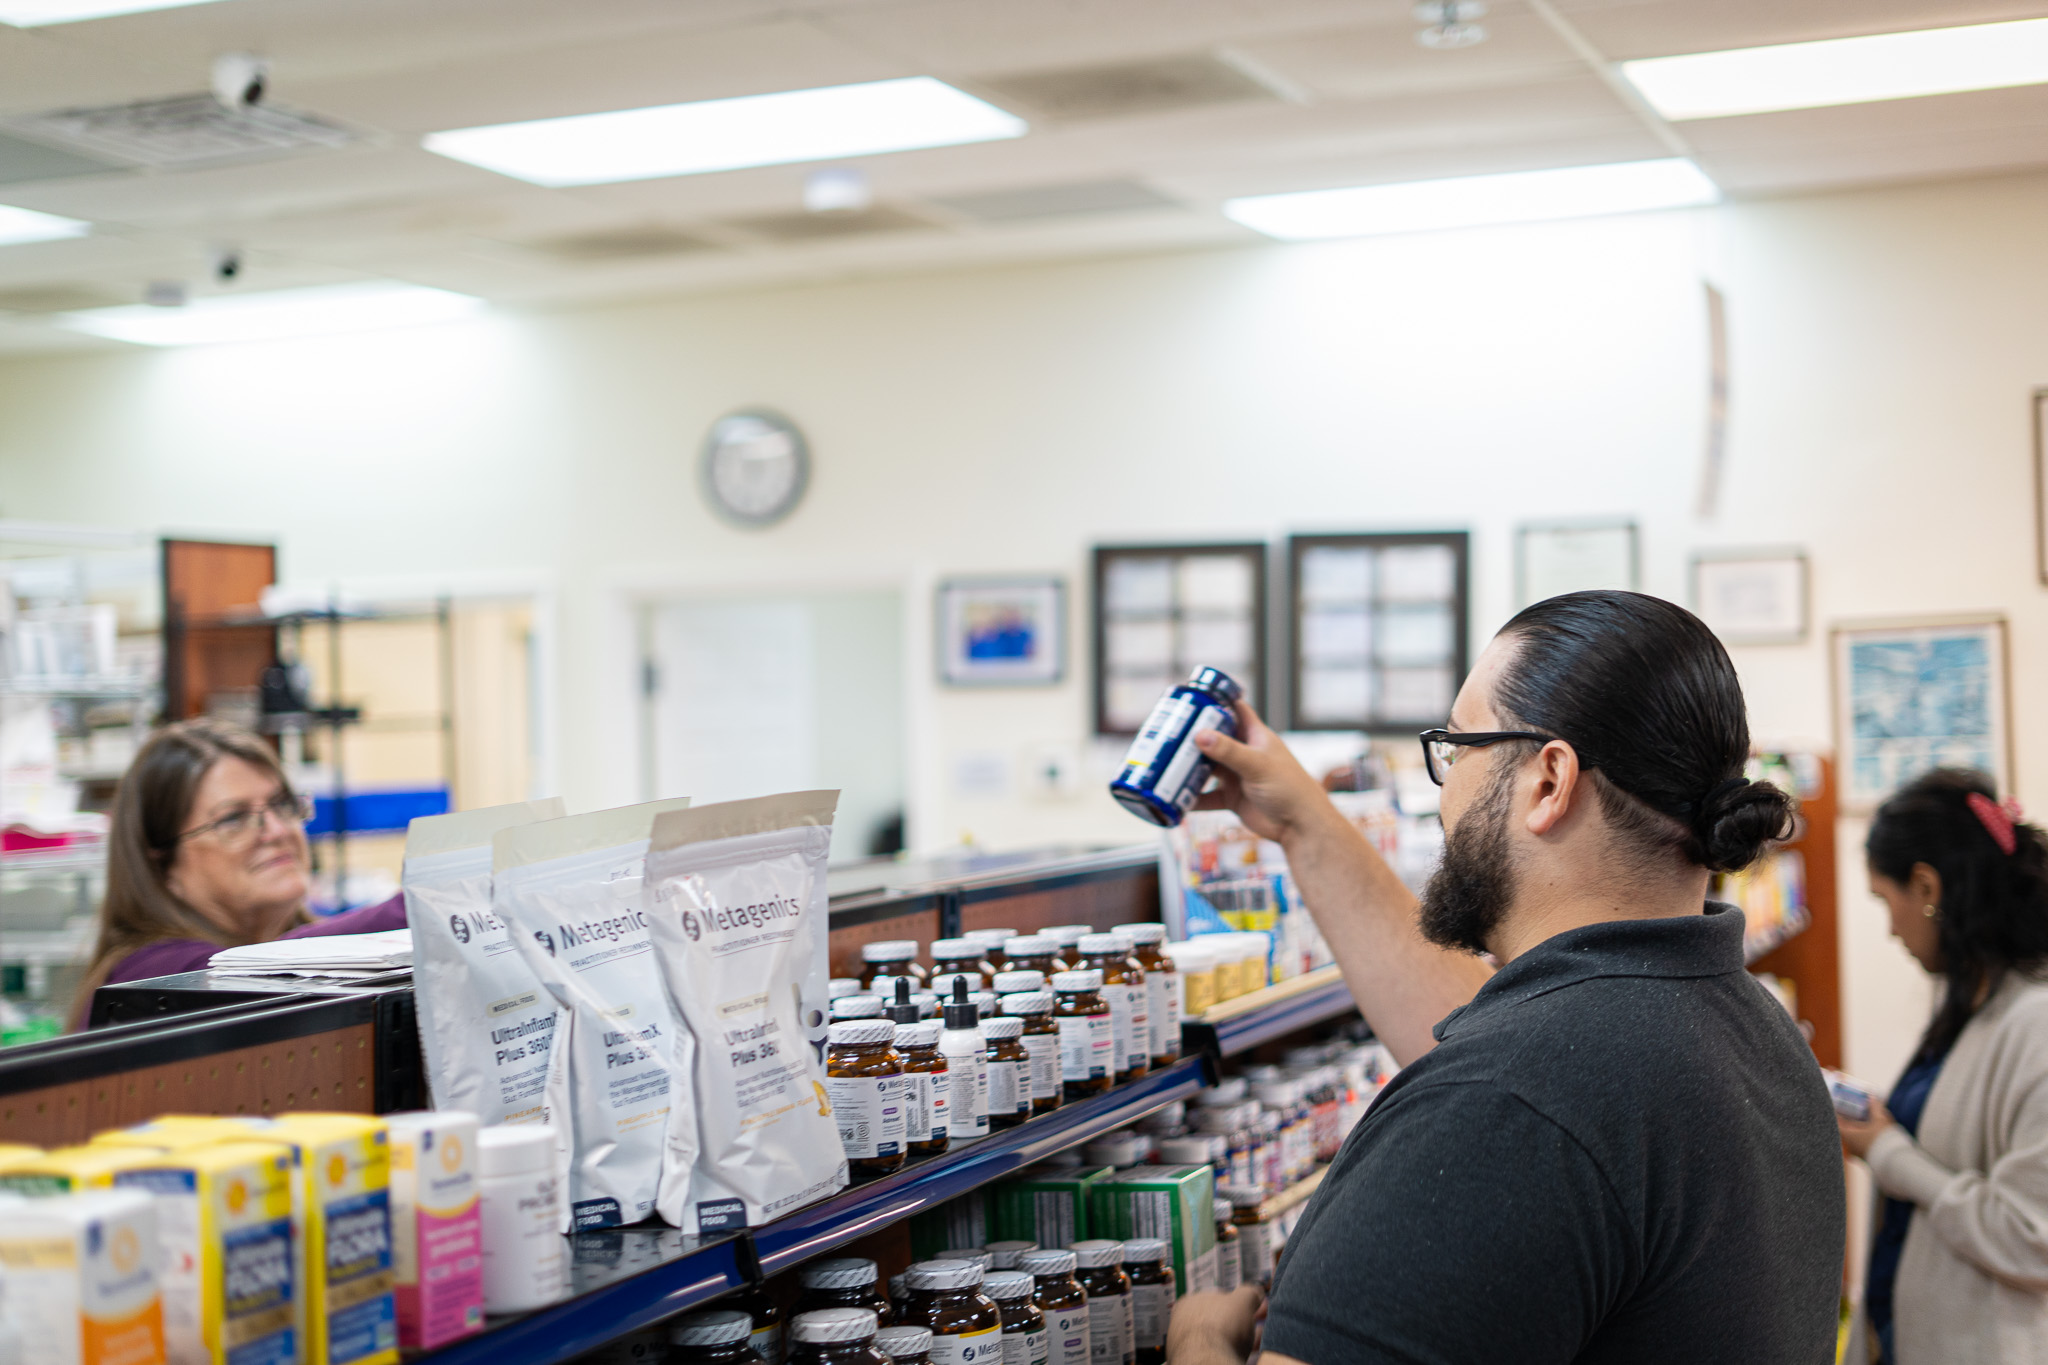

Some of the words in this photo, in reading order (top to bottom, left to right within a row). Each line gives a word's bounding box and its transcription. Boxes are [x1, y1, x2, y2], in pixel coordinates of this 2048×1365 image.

[469, 910, 506, 934] Met
[701, 894, 801, 933] Metagenics
[559, 908, 649, 950] Metagenic
[495, 1045, 526, 1067] Plus
[605, 1051, 635, 1070] Plus
[730, 1049, 757, 1069] Plus
[574, 1201, 618, 1217] MEDICAL
[700, 1203, 744, 1217] MEDICAL
[577, 1213, 604, 1227] FOOD
[701, 1214, 728, 1227] FOOD
